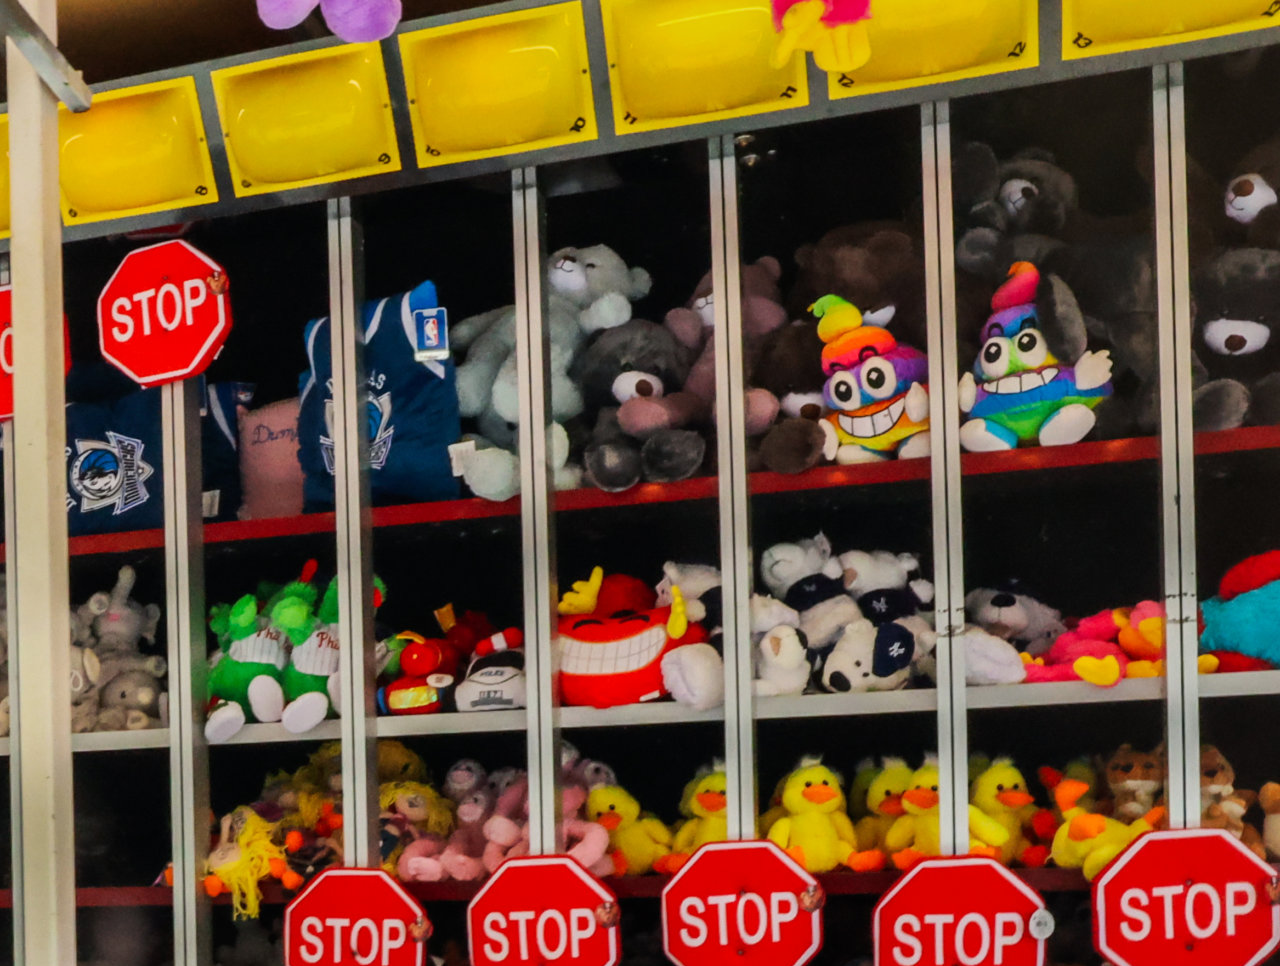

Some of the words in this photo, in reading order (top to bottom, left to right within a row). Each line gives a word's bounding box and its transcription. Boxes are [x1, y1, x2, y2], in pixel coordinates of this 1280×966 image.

[1007, 40, 1027, 58] 12
[569, 116, 587, 133] 10
[111, 277, 208, 343] STOP
[483, 908, 597, 963] STOP
[679, 891, 799, 948] STOP
[1120, 880, 1257, 942] STOP
[299, 916, 407, 966] STOP
